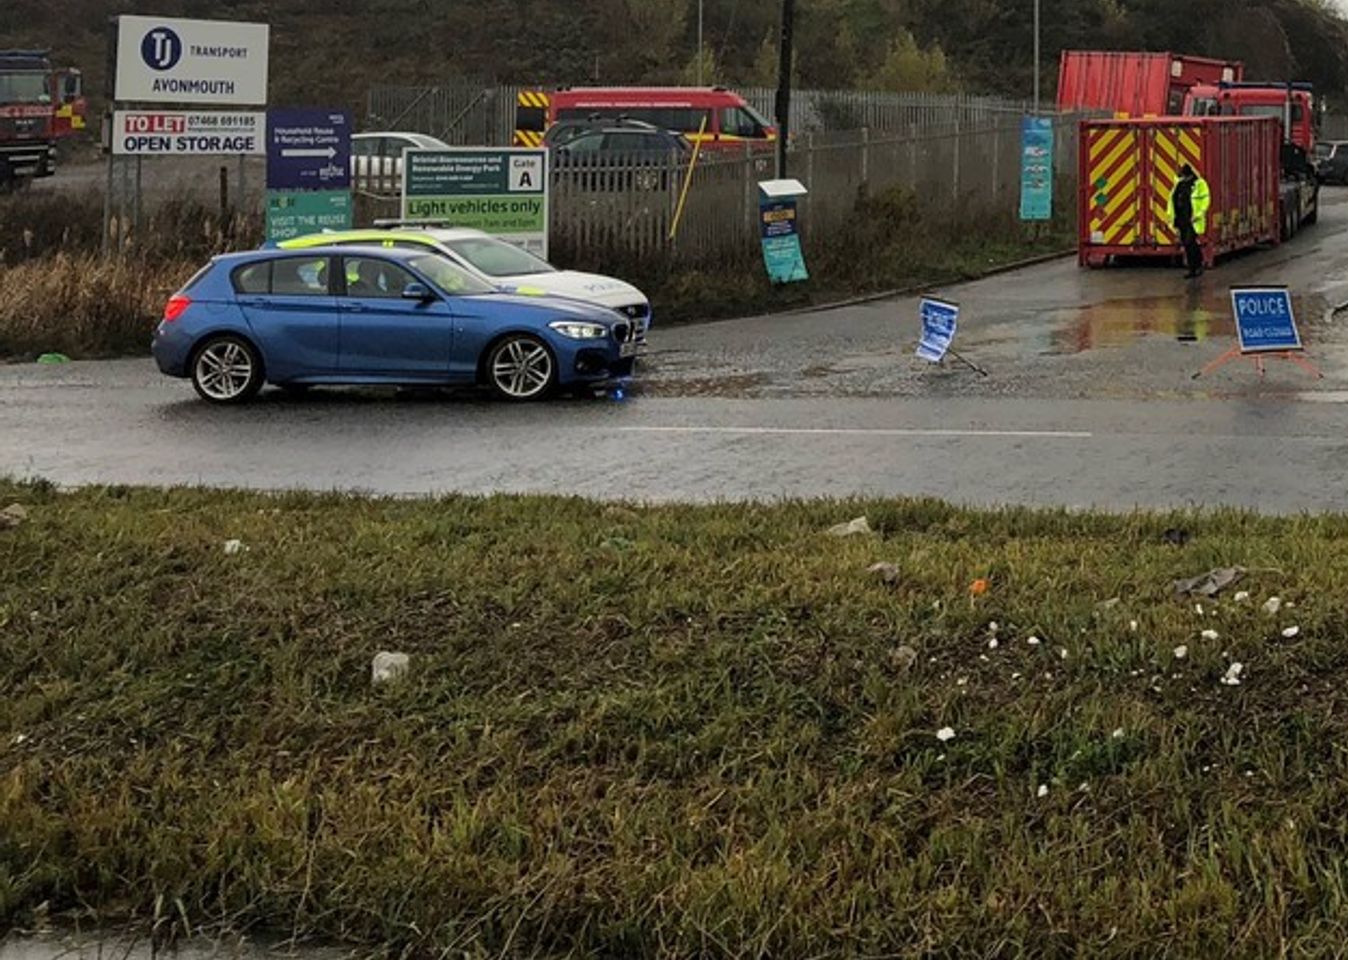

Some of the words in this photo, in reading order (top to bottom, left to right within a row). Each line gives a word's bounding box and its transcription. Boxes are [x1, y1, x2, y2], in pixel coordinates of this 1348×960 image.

[190, 45, 247, 59] TRANSPORT
[152, 78, 235, 94] AVONMOUTH
[127, 116, 149, 131] TO
[154, 116, 184, 132] LET
[124, 136, 171, 151] OPEN
[177, 136, 255, 151] STORAGE
[513, 160, 536, 168] Gate
[520, 172, 532, 187] A
[409, 201, 446, 216] Light
[449, 200, 508, 213] vehicles
[511, 200, 541, 215] only
[1239, 297, 1286, 315] POLICE
